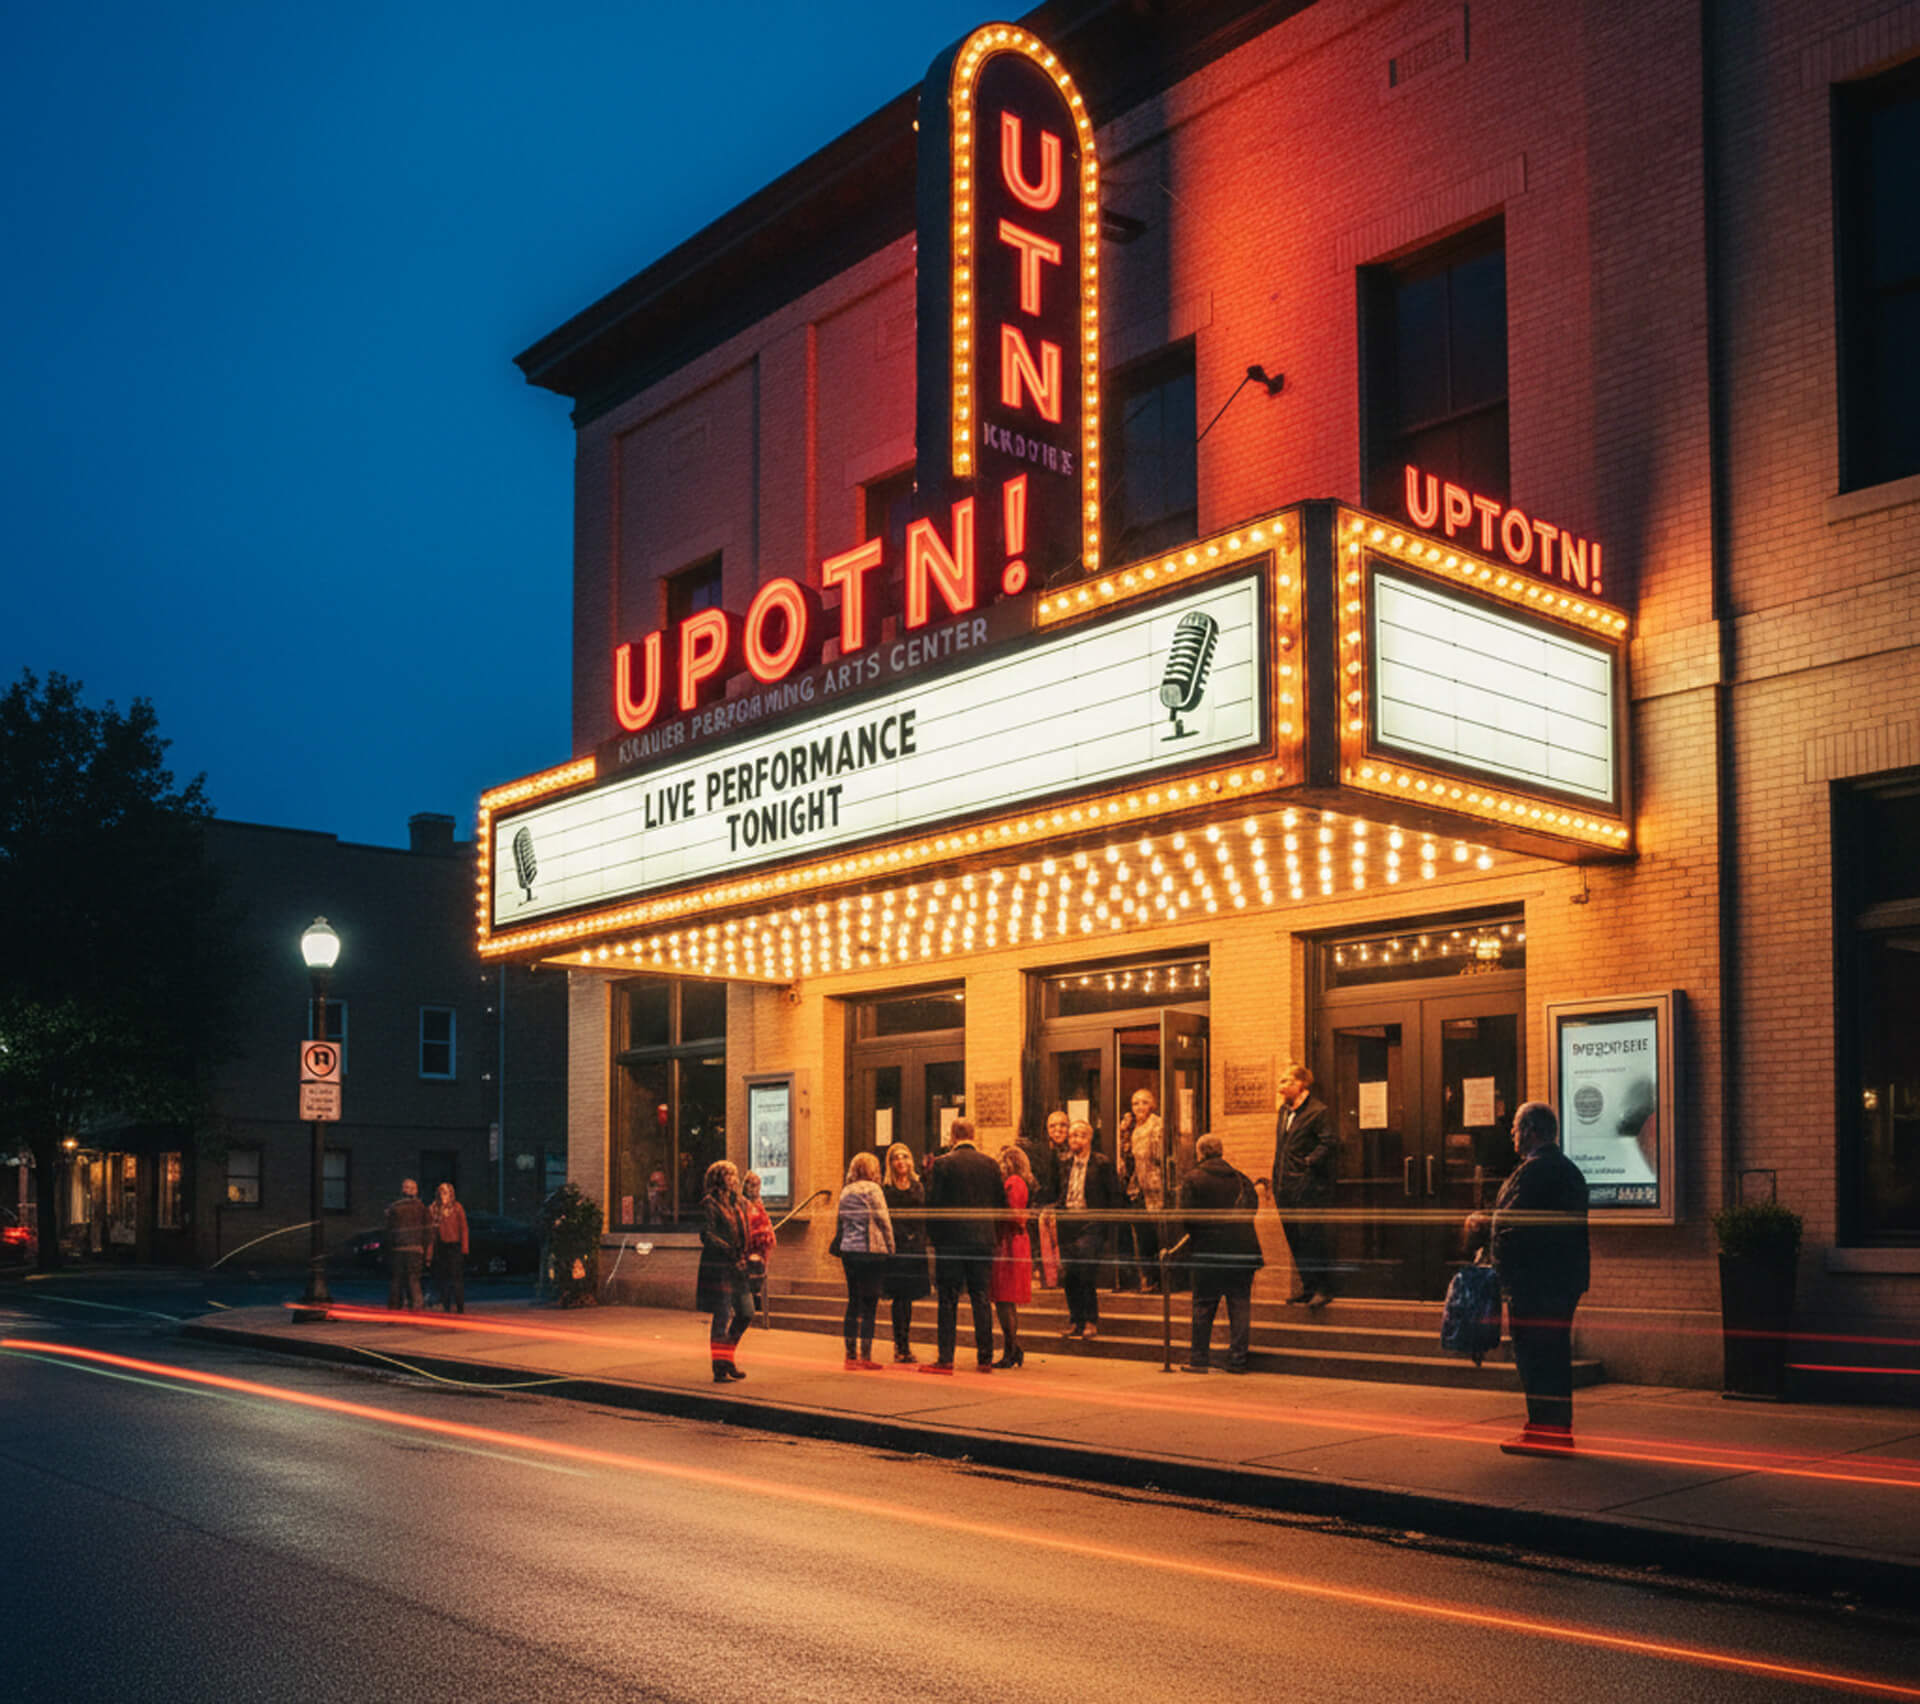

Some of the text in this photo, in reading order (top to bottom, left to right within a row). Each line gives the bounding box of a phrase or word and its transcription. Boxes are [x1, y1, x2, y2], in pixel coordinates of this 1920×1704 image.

[1405, 464, 1602, 595] UPTOTN!
[615, 473, 1028, 732] UPOTN!
[823, 652, 881, 695] ARTS
[890, 617, 988, 672] CENTER
[644, 710, 917, 829] LIVE PERFORMANCE
[726, 784, 843, 852] TONIGHT
